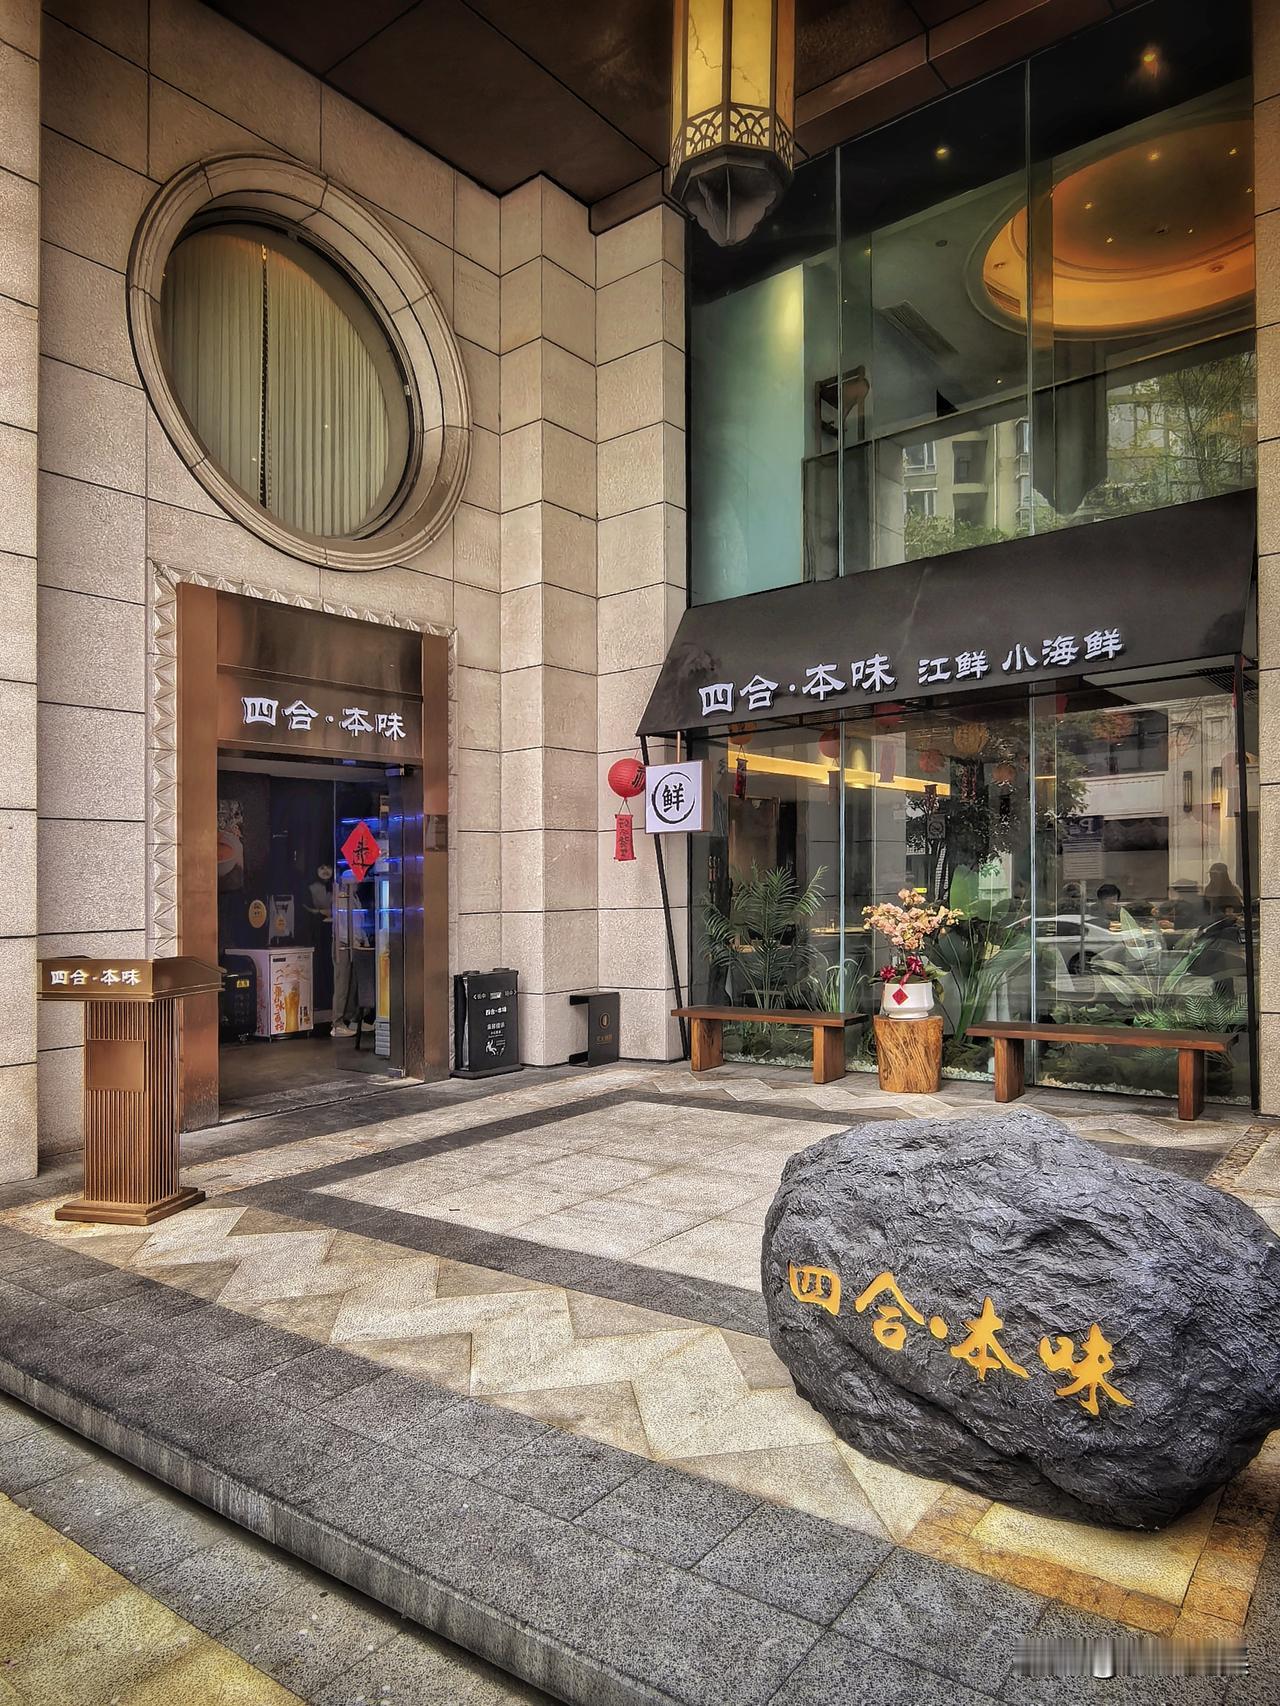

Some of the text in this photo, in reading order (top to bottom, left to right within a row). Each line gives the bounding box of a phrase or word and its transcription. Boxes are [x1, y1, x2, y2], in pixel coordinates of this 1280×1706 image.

[698, 628, 1123, 717] 四合·本味 江鲜 小海鲜
[241, 696, 408, 741] 四合·本味
[662, 782, 685, 813] 鲜
[50, 969, 142, 986] 四合·本味
[787, 1262, 1135, 1416] 四合·本味
